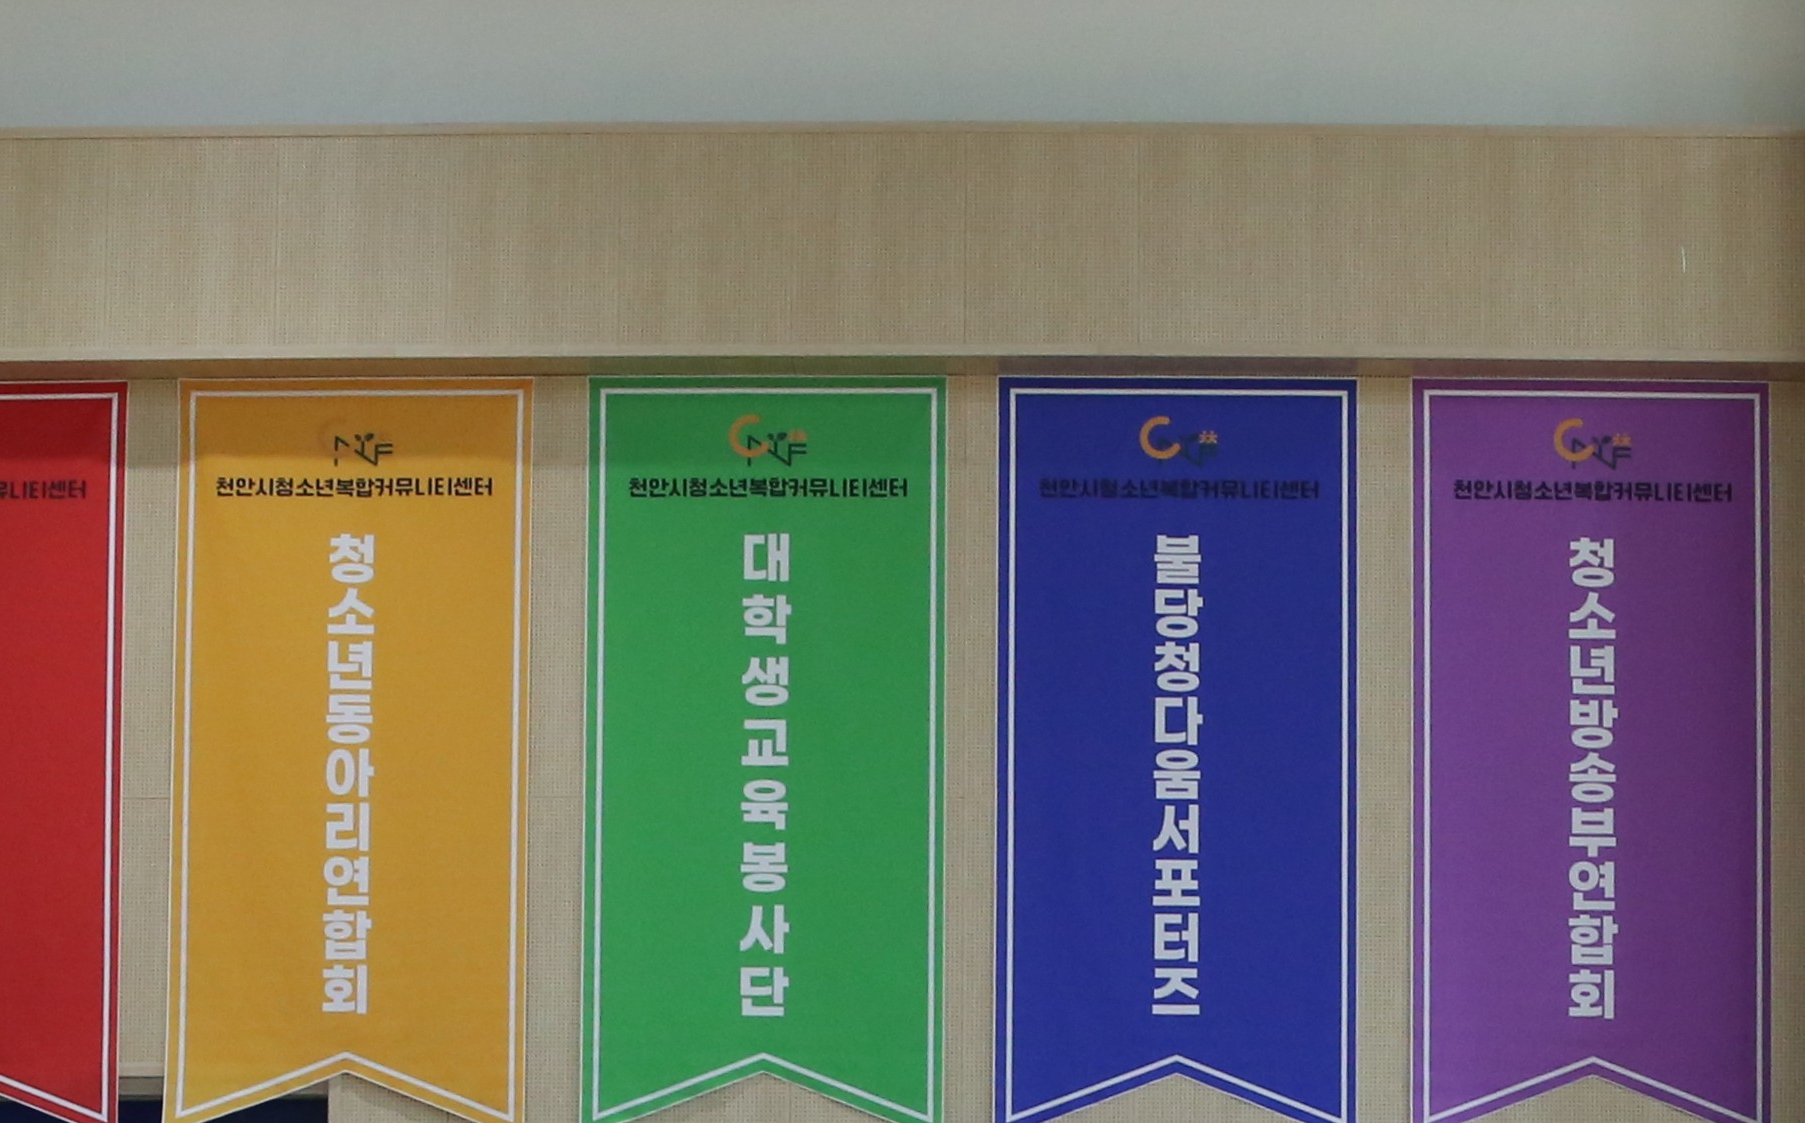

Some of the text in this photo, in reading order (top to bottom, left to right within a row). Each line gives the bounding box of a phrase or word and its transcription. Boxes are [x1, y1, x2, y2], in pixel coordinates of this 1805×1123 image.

[215, 477, 494, 497] 천안시청소년복합커뮤니티센터
[629, 477, 908, 498] 천안시청소년복합커뮤니티센터
[1453, 480, 1733, 502] 천안시청소년복합커뮤니티센터
[322, 533, 376, 1015] 청소년동아리연합회
[738, 532, 791, 1018] 대학생교육봉사단
[1152, 534, 1204, 1017] 불당청다움서포터즈
[1567, 537, 1618, 1020] 청소년방송부연합회
